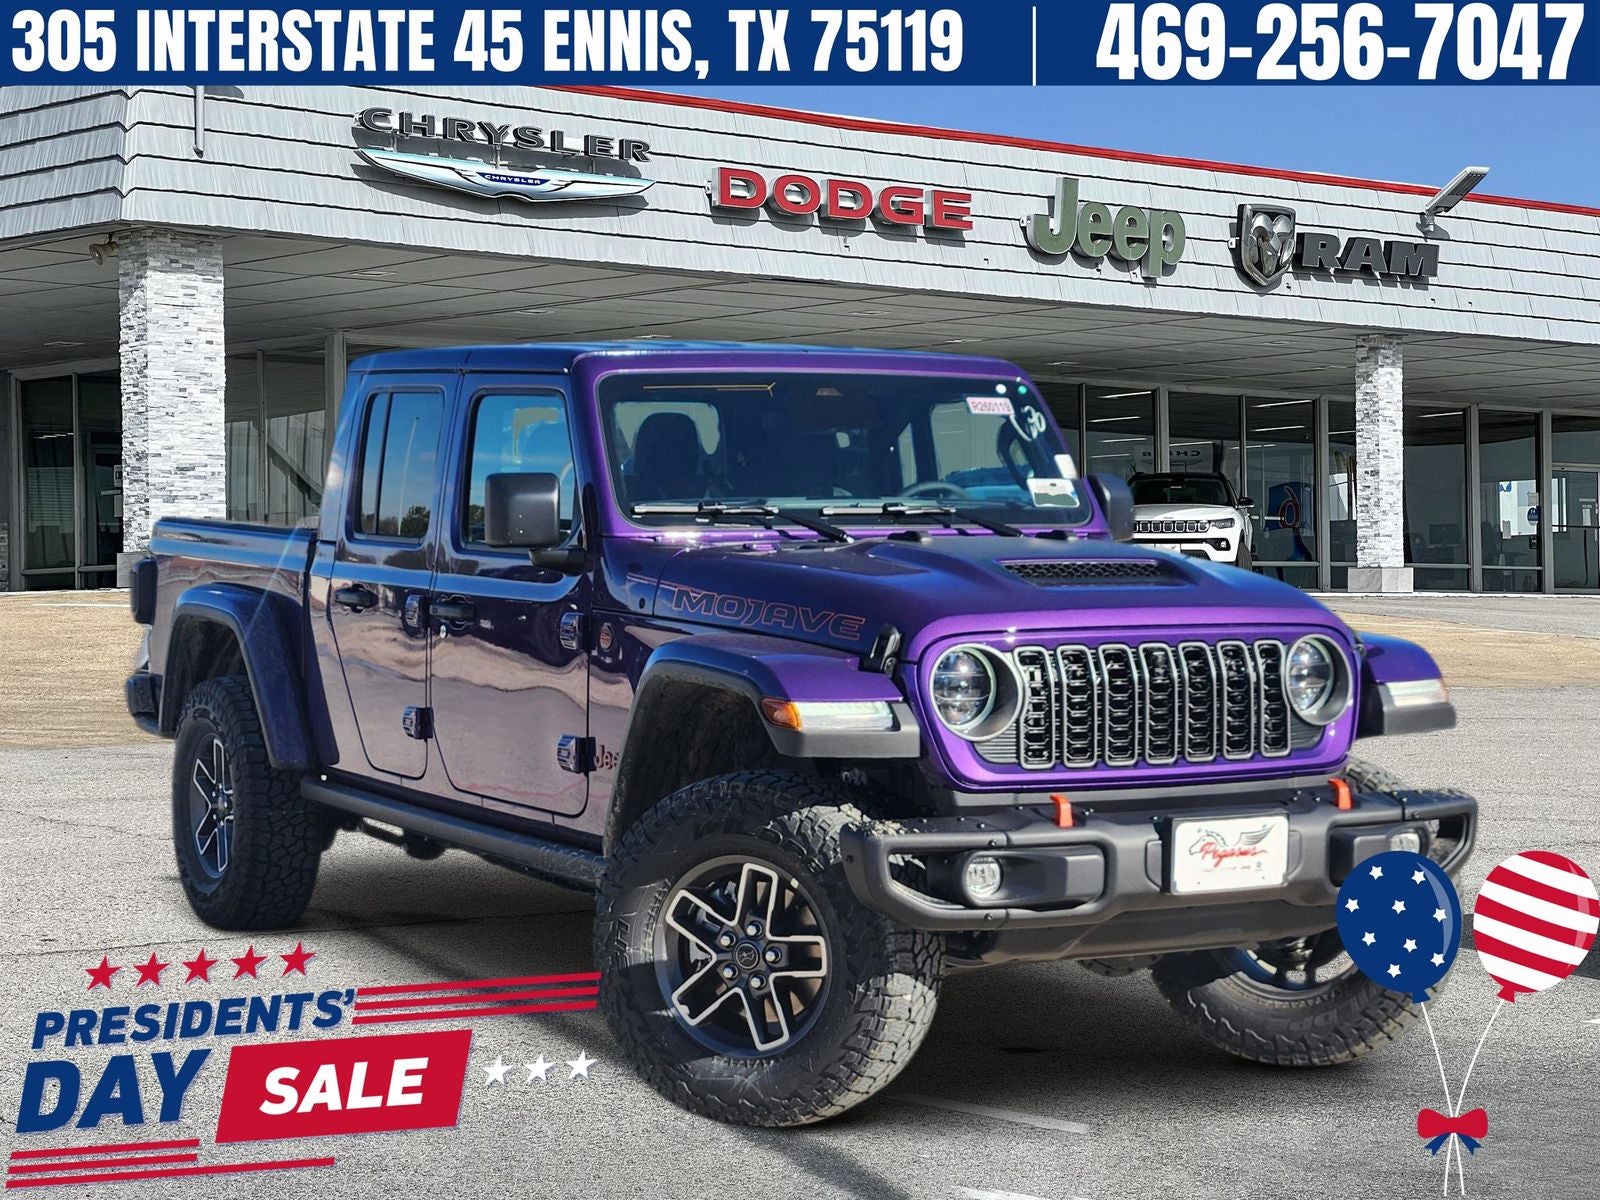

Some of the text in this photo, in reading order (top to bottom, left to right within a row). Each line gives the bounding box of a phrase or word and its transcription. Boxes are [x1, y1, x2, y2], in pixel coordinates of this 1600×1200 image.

[356, 106, 652, 162] CHRYSLER
[484, 173, 542, 185] CHRYSLER
[712, 166, 974, 231] DODGE
[1030, 177, 1186, 278] Jeep
[1301, 231, 1440, 278] RAM
[671, 586, 866, 640] MOJAVE
